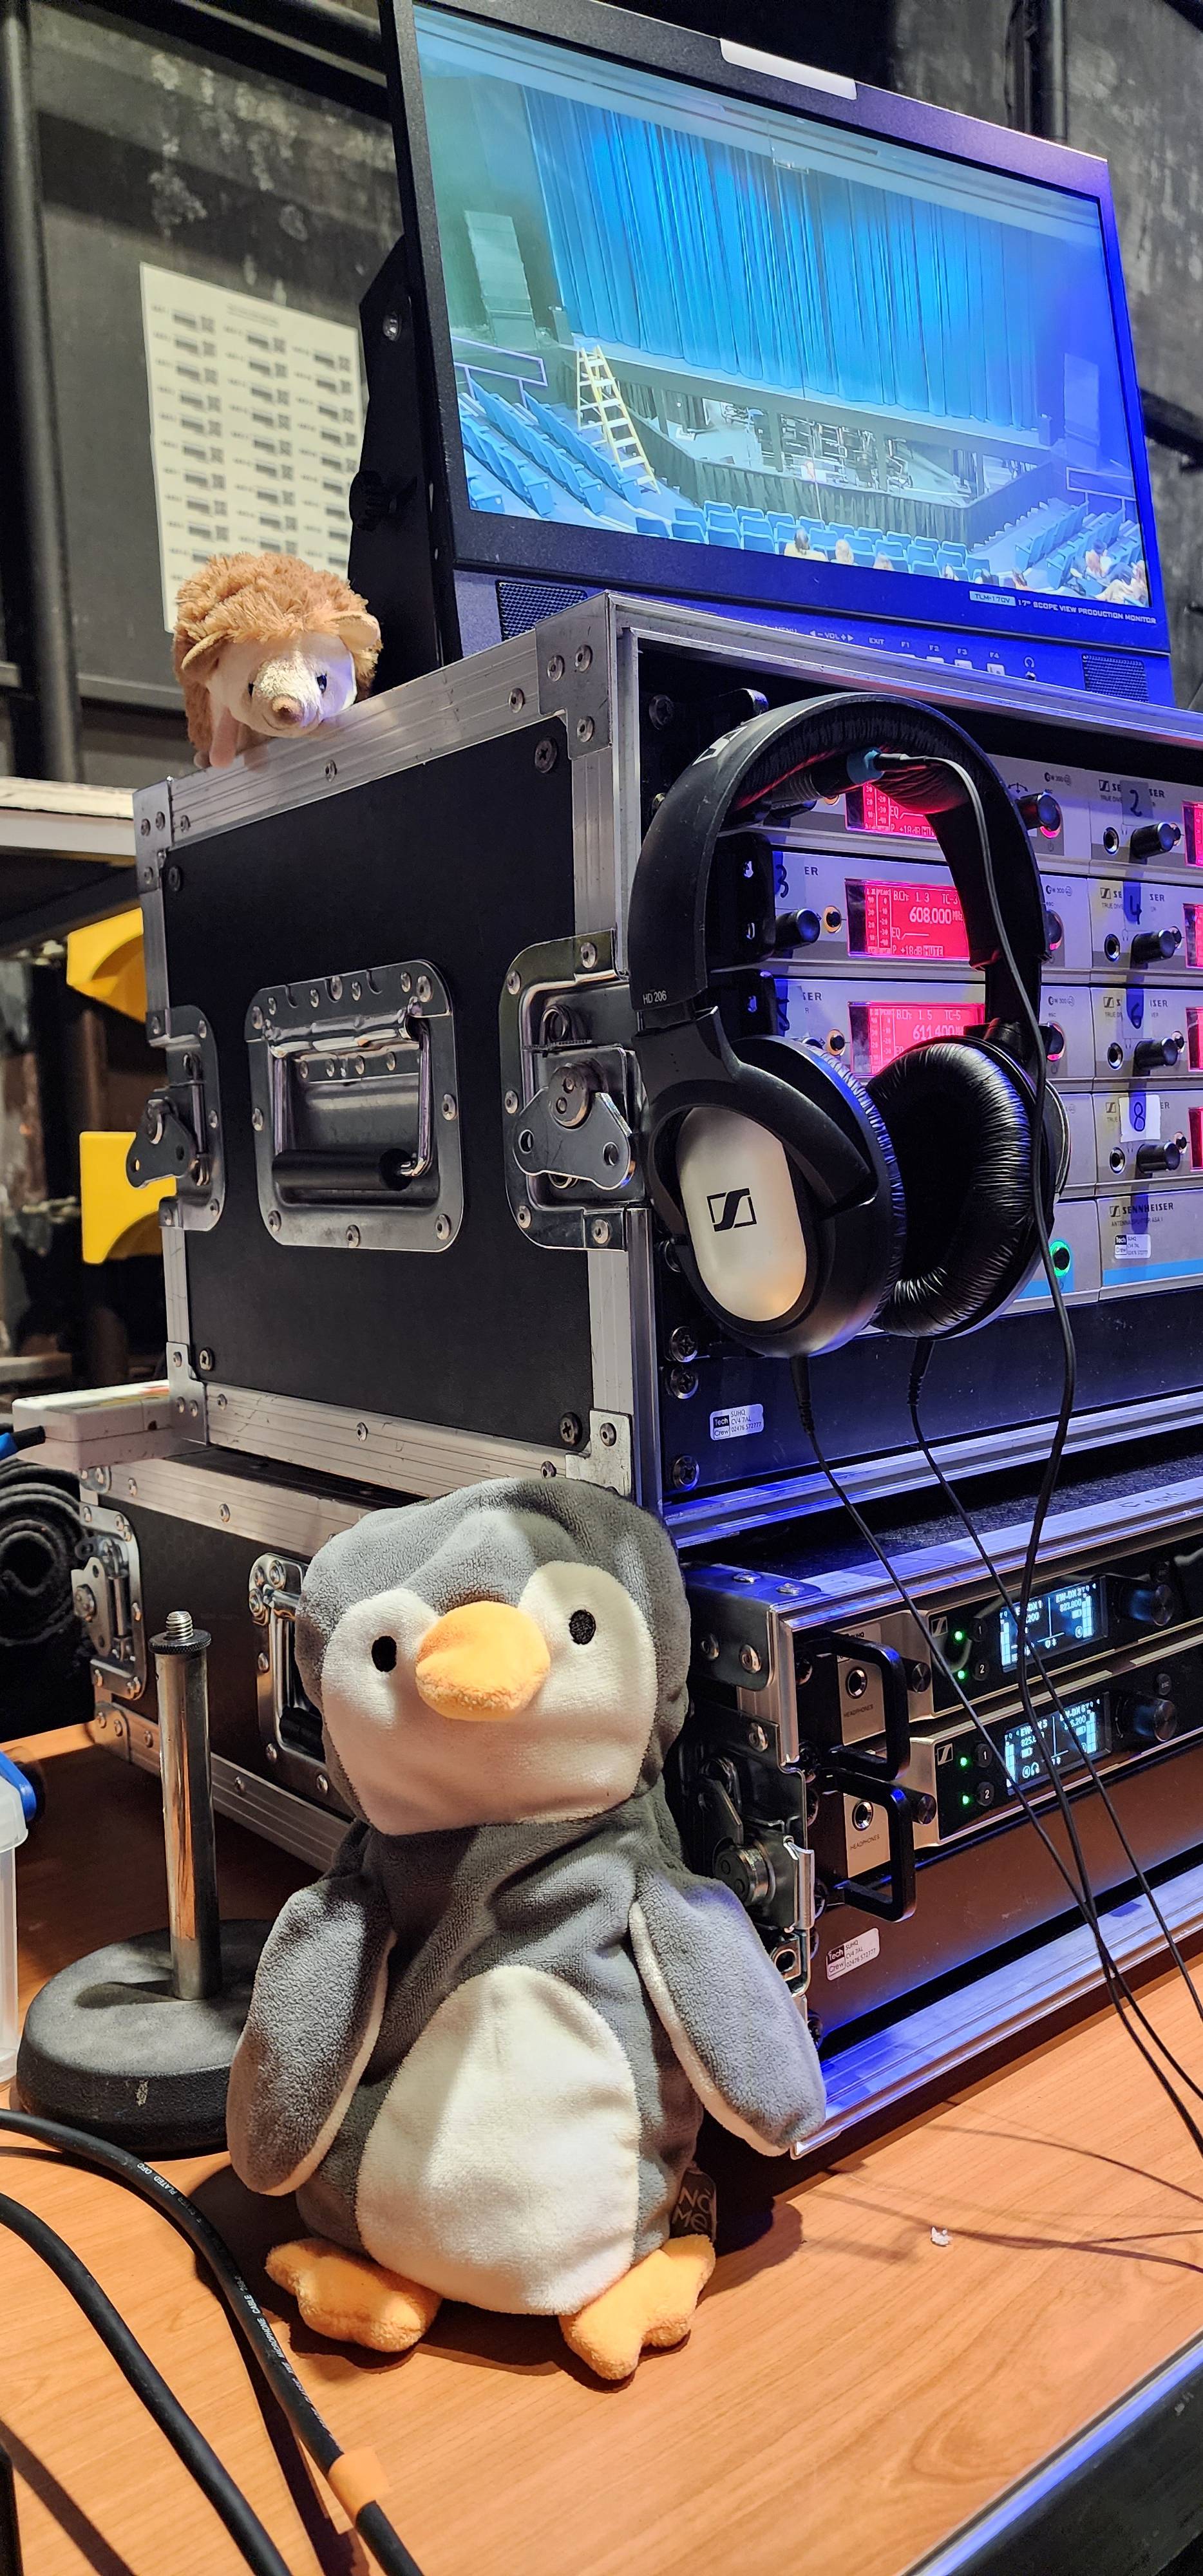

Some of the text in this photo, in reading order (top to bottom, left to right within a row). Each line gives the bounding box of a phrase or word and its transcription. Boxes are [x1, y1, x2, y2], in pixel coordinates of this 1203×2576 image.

[1033, 601, 1058, 611] SCOPE
[1059, 605, 1077, 613] VIEW
[1078, 607, 1124, 620] PRODUCTION
[1124, 614, 1157, 624] MONITOR
[890, 806, 899, 819] EQ
[909, 906, 951, 924] 608.000
[891, 927, 901, 940] EQ
[923, 945, 943, 956] MUTE
[643, 990, 667, 1005] HD 206
[1133, 1102, 1146, 1132] 8
[1122, 1202, 1174, 1215] SENNHEISER
[731, 1409, 746, 1417] SUHQ
[715, 1417, 728, 1426] Tech
[978, 1625, 982, 1634] 1
[980, 1665, 985, 1674] 2
[983, 1751, 987, 1760] 1
[985, 1789, 990, 1799] 2
[828, 1949, 844, 1960] Tech
[829, 1962, 844, 1973] Crew
[137, 2163, 153, 2175] OFC
[154, 2175, 178, 2195] PLATED
[243, 2295, 261, 2315] CABLE
[257, 2318, 285, 2358] MICROPHONE
